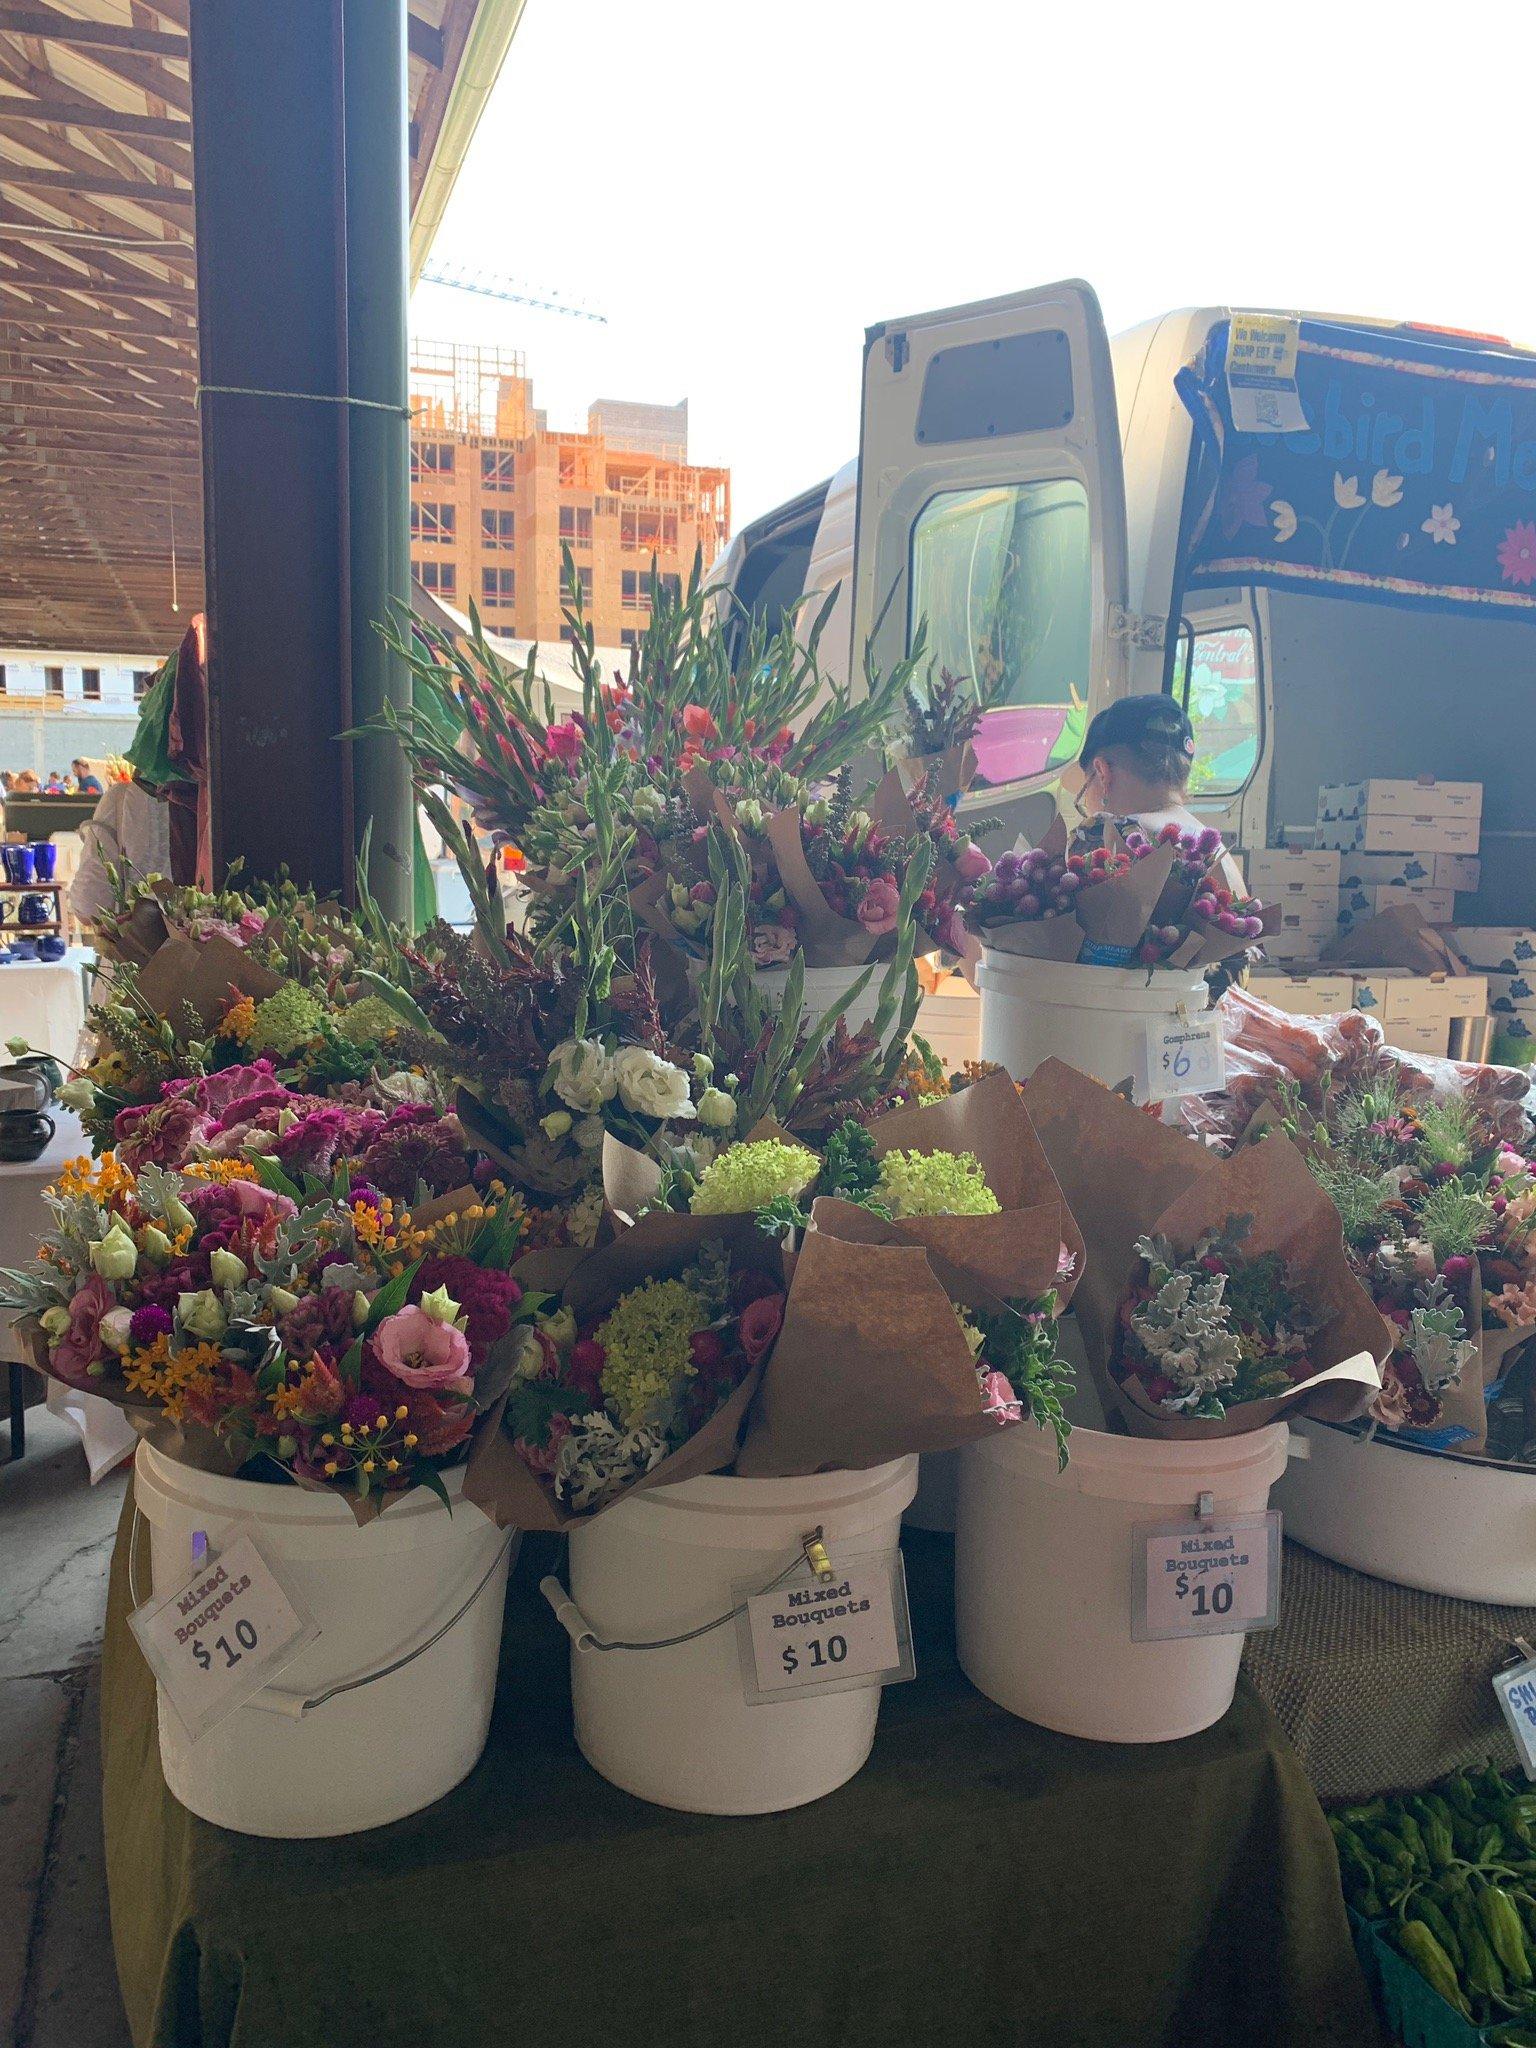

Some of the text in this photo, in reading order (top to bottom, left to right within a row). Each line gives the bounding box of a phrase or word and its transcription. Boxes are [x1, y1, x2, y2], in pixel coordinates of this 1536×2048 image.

[1163, 1031, 1211, 1045] Gomphrena
[1181, 1535, 1235, 1554] Mixed
[1166, 1553, 1249, 1574] Bouquets
[176, 1565, 229, 1617] Mixed
[788, 1581, 852, 1608] Mixed
[174, 1574, 252, 1645] Bouquets
[772, 1599, 871, 1630] Bouquets
